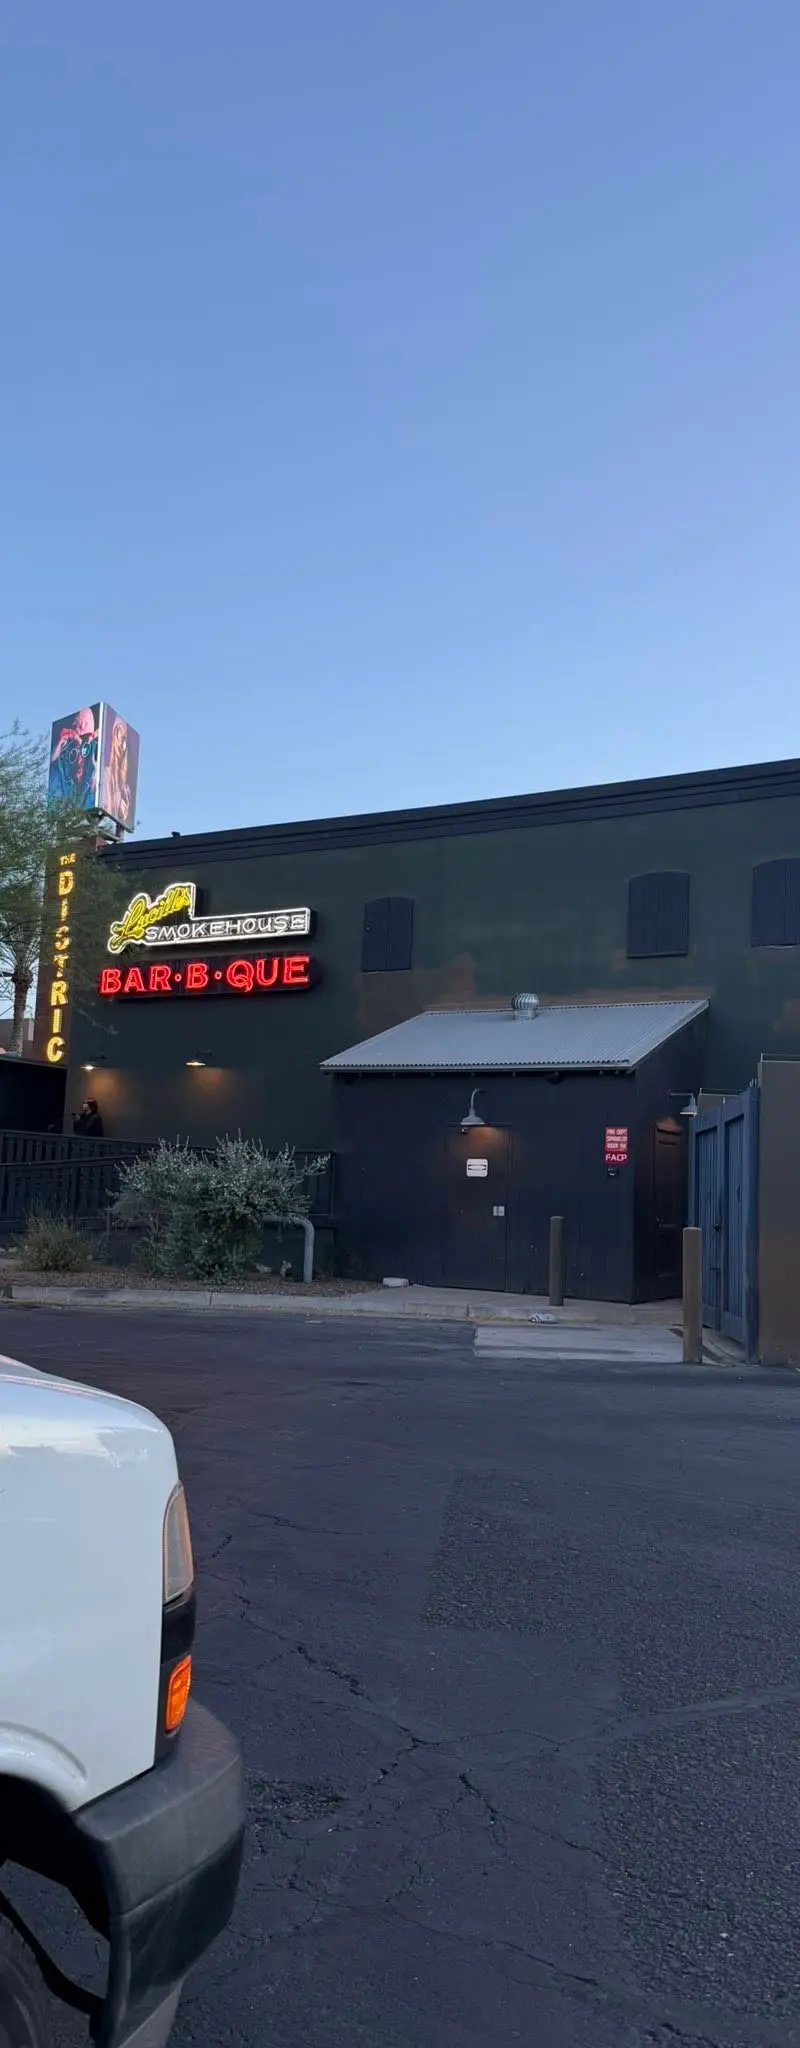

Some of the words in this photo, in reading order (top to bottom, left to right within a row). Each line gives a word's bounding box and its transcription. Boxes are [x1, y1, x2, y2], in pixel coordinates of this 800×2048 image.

[60, 853, 76, 865] THE
[110, 886, 190, 950] Lucille's
[145, 913, 306, 940] SMOKEHOUSE
[605, 1153, 627, 1161] FACP
